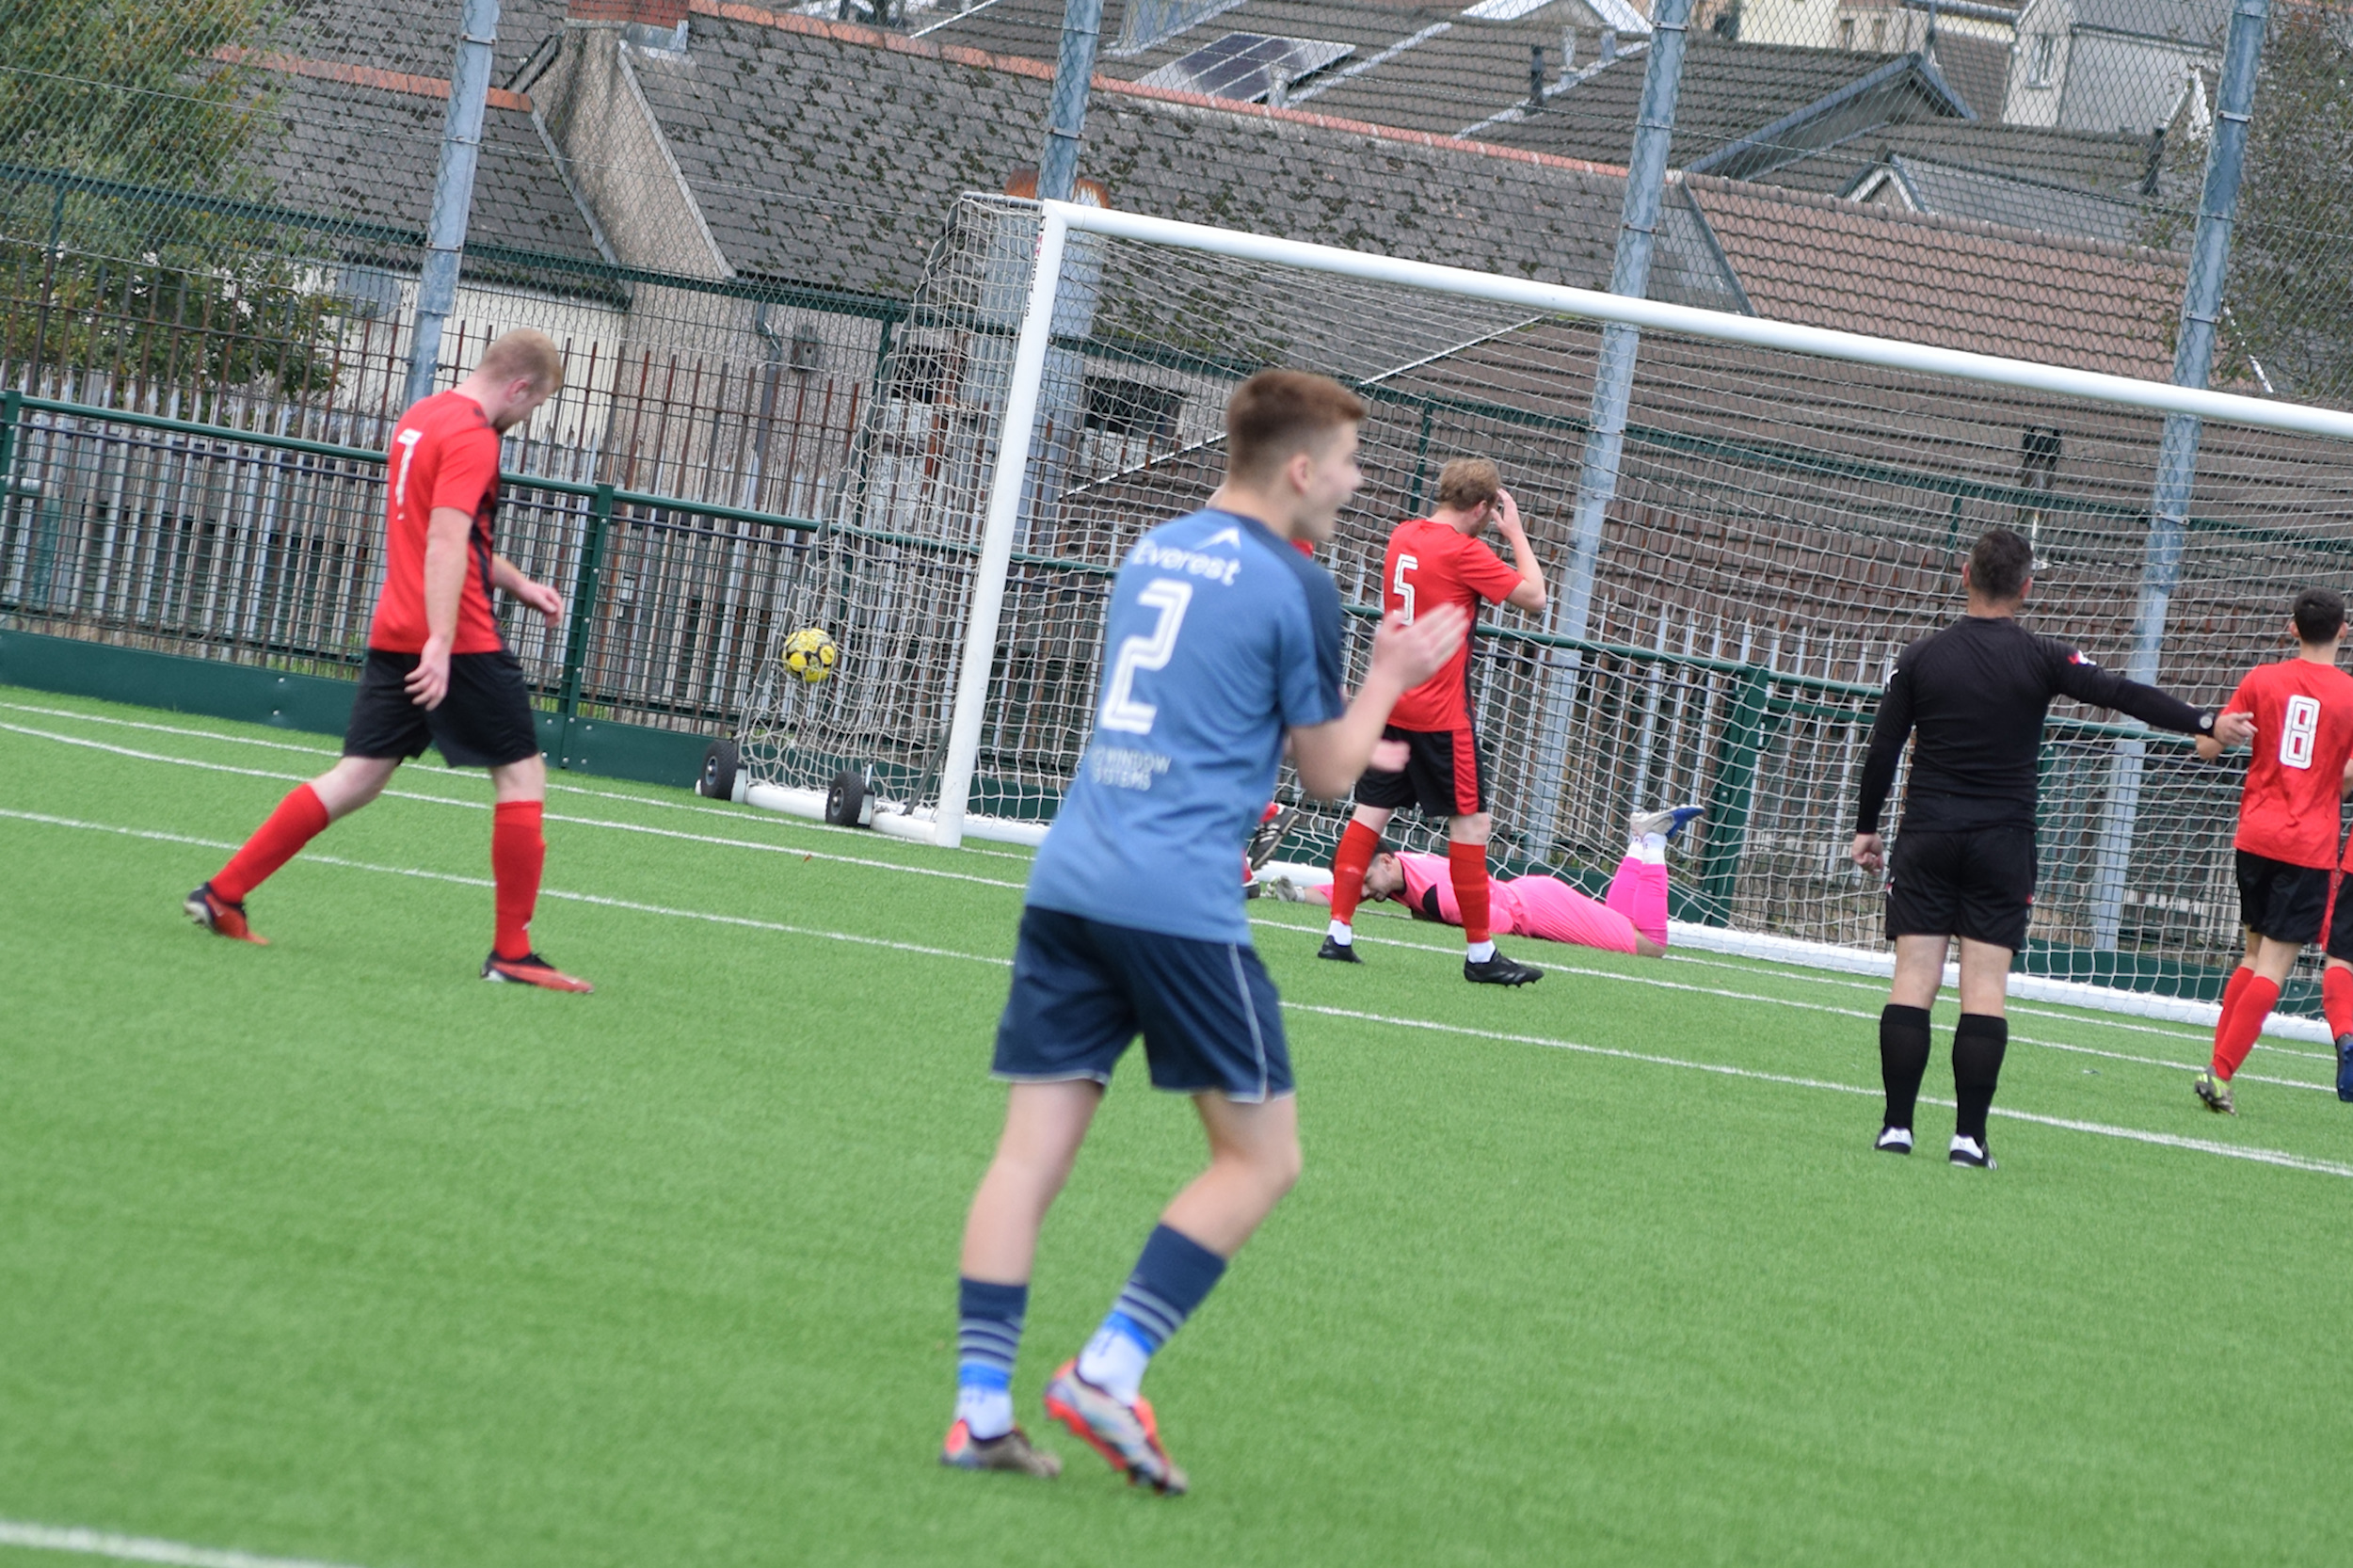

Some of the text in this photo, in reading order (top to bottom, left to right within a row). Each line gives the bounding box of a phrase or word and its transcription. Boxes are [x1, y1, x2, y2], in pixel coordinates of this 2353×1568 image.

[395, 428, 423, 520] 7
[1131, 538, 1241, 586] Everest
[1393, 553, 1418, 626] 5
[1098, 578, 1193, 734] 2
[2280, 694, 2321, 769] 8
